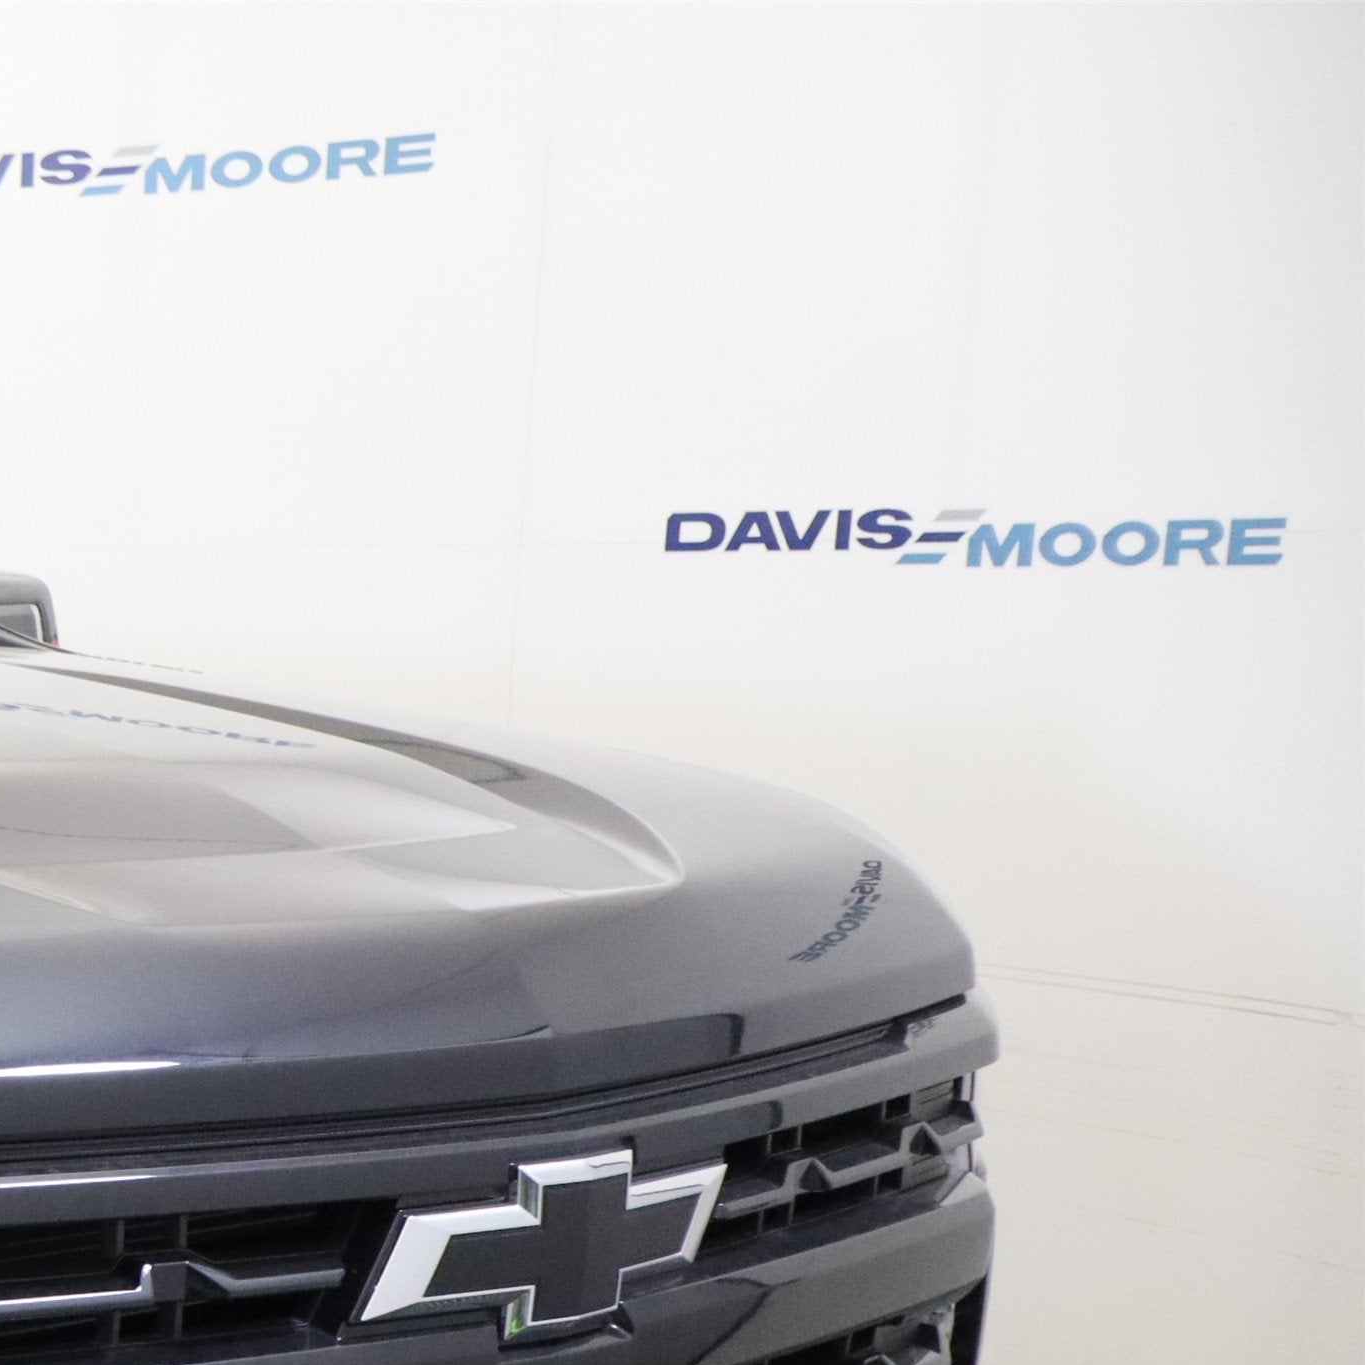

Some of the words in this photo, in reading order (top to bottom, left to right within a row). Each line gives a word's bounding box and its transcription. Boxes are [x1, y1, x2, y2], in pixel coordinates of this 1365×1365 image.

[144, 131, 437, 195] MOORE
[665, 507, 913, 552] DAVIS
[967, 516, 1288, 568] MOORE
